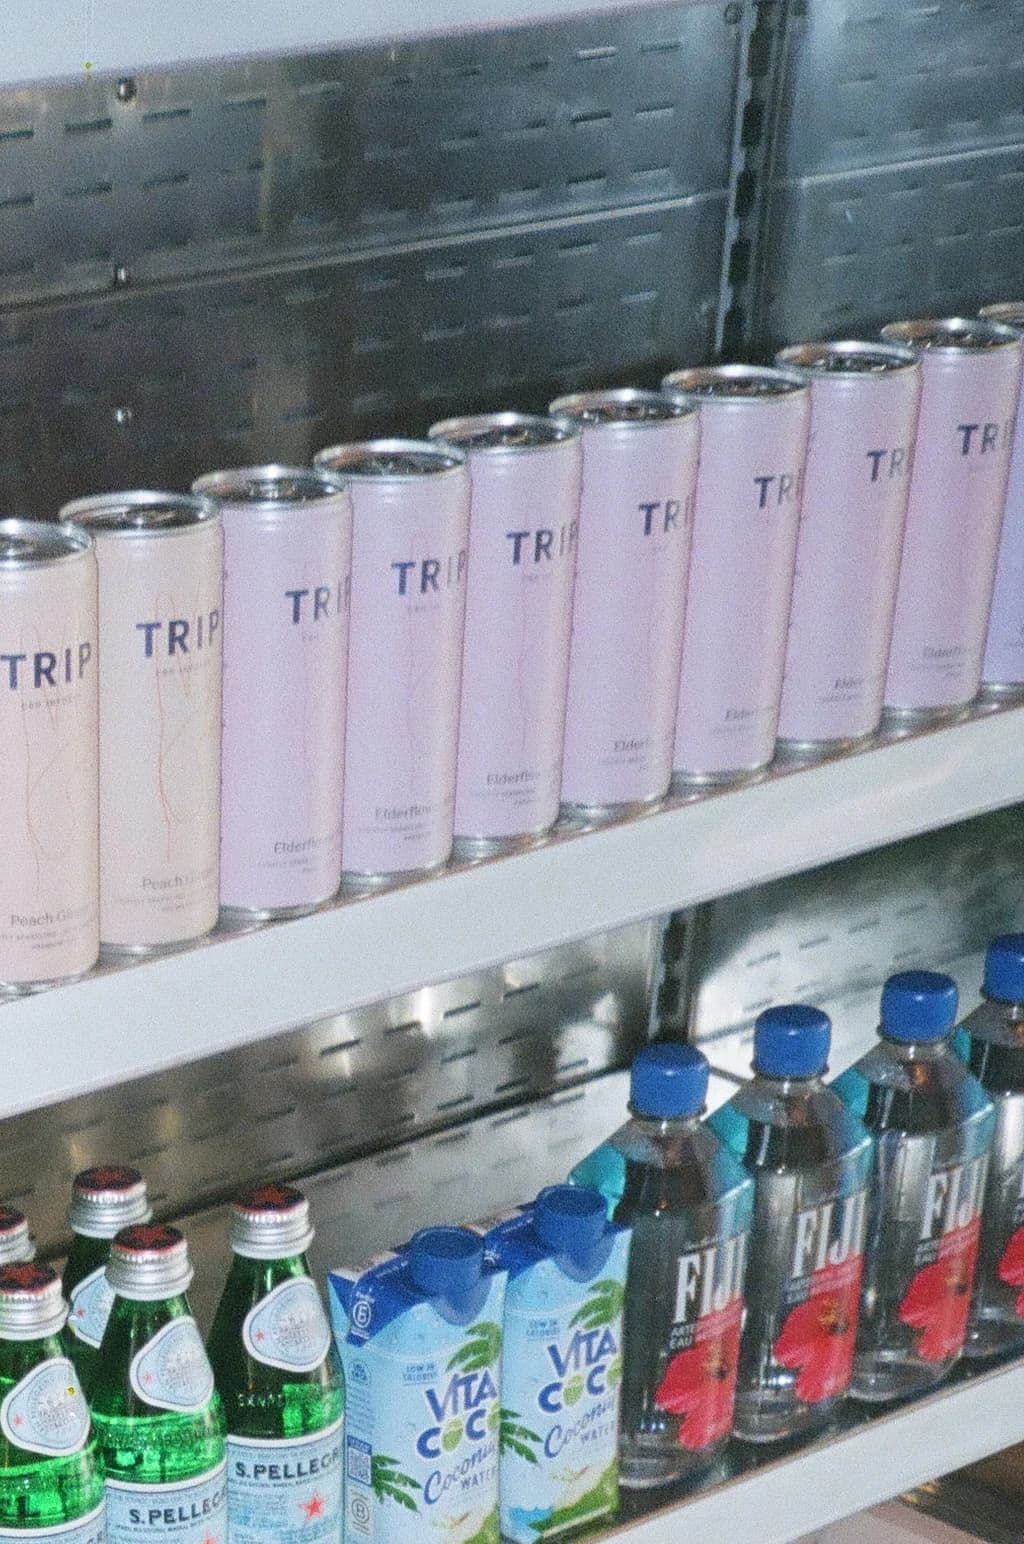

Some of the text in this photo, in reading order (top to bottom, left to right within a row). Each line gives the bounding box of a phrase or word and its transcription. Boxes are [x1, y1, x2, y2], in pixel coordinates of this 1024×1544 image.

[136, 608, 219, 658] TRIP
[0, 641, 93, 691] TRIP
[792, 1190, 866, 1279] FIJI
[673, 1232, 745, 1324] FIJI
[547, 1327, 617, 1378] VITA
[425, 1369, 498, 1424] VITA
